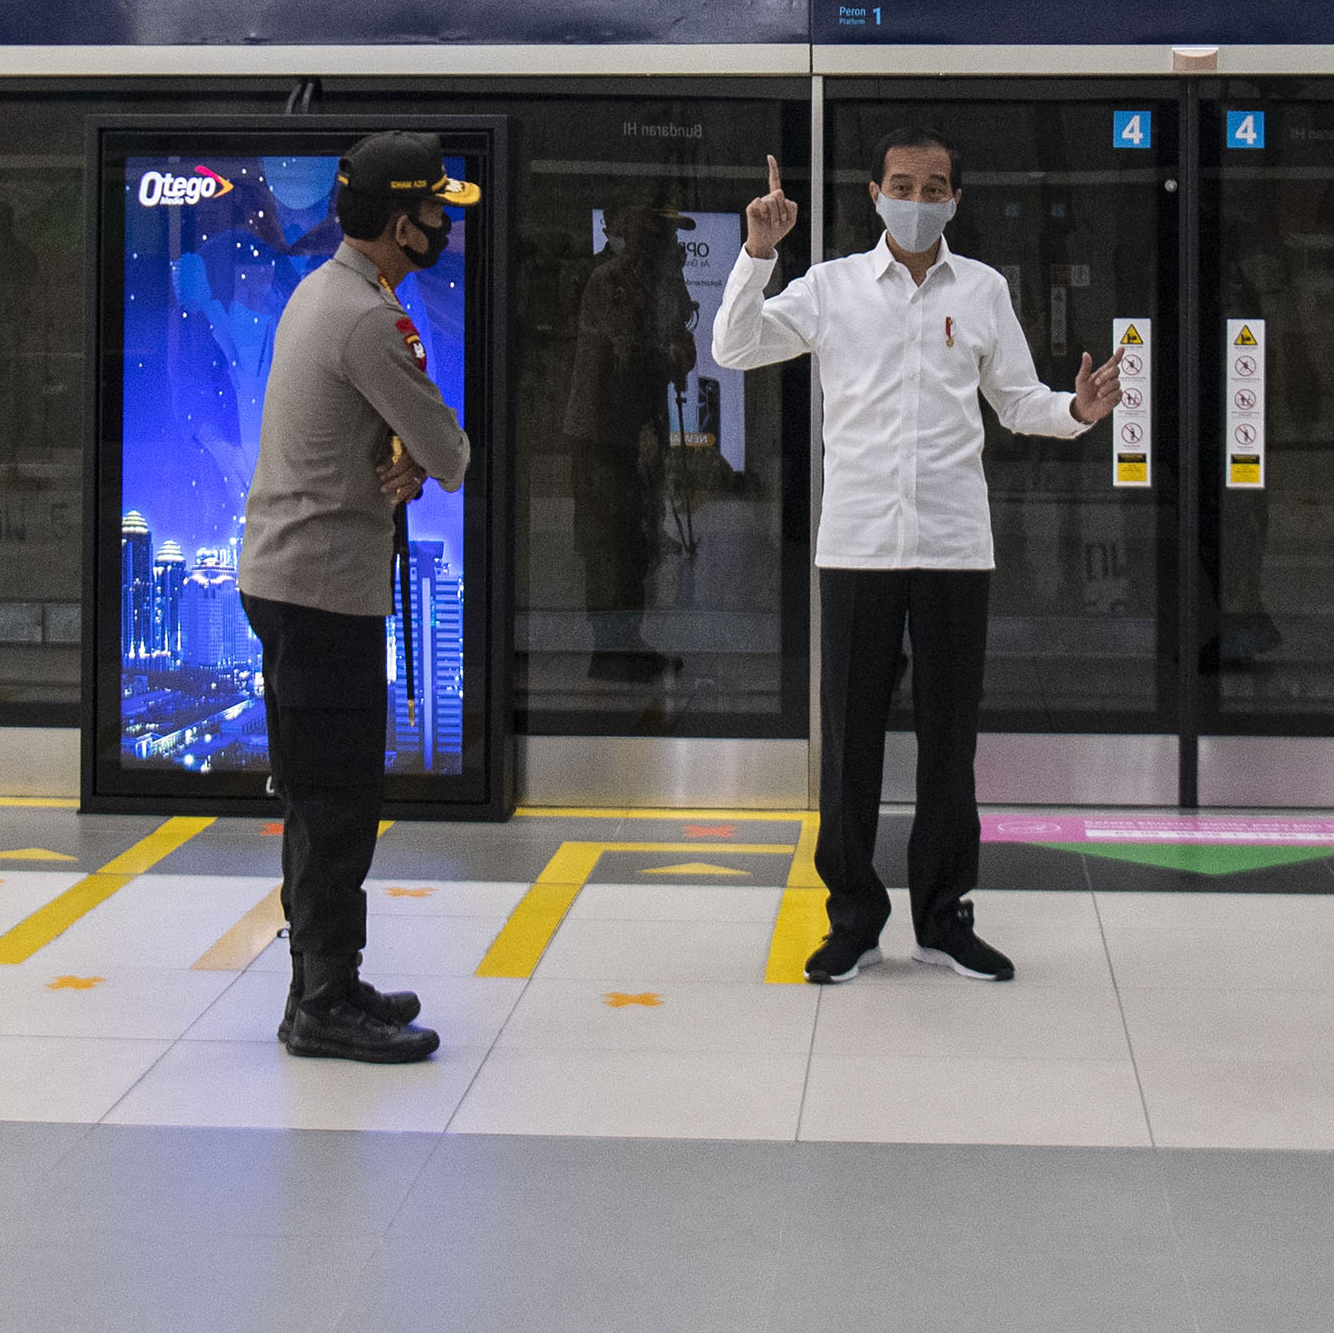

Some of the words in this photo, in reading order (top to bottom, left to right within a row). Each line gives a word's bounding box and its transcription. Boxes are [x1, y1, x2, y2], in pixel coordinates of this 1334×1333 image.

[838, 6, 867, 17] Peron
[872, 6, 882, 26] 1
[1121, 115, 1144, 144] 4
[1235, 115, 1258, 144] 4
[138, 170, 216, 206] Otego
